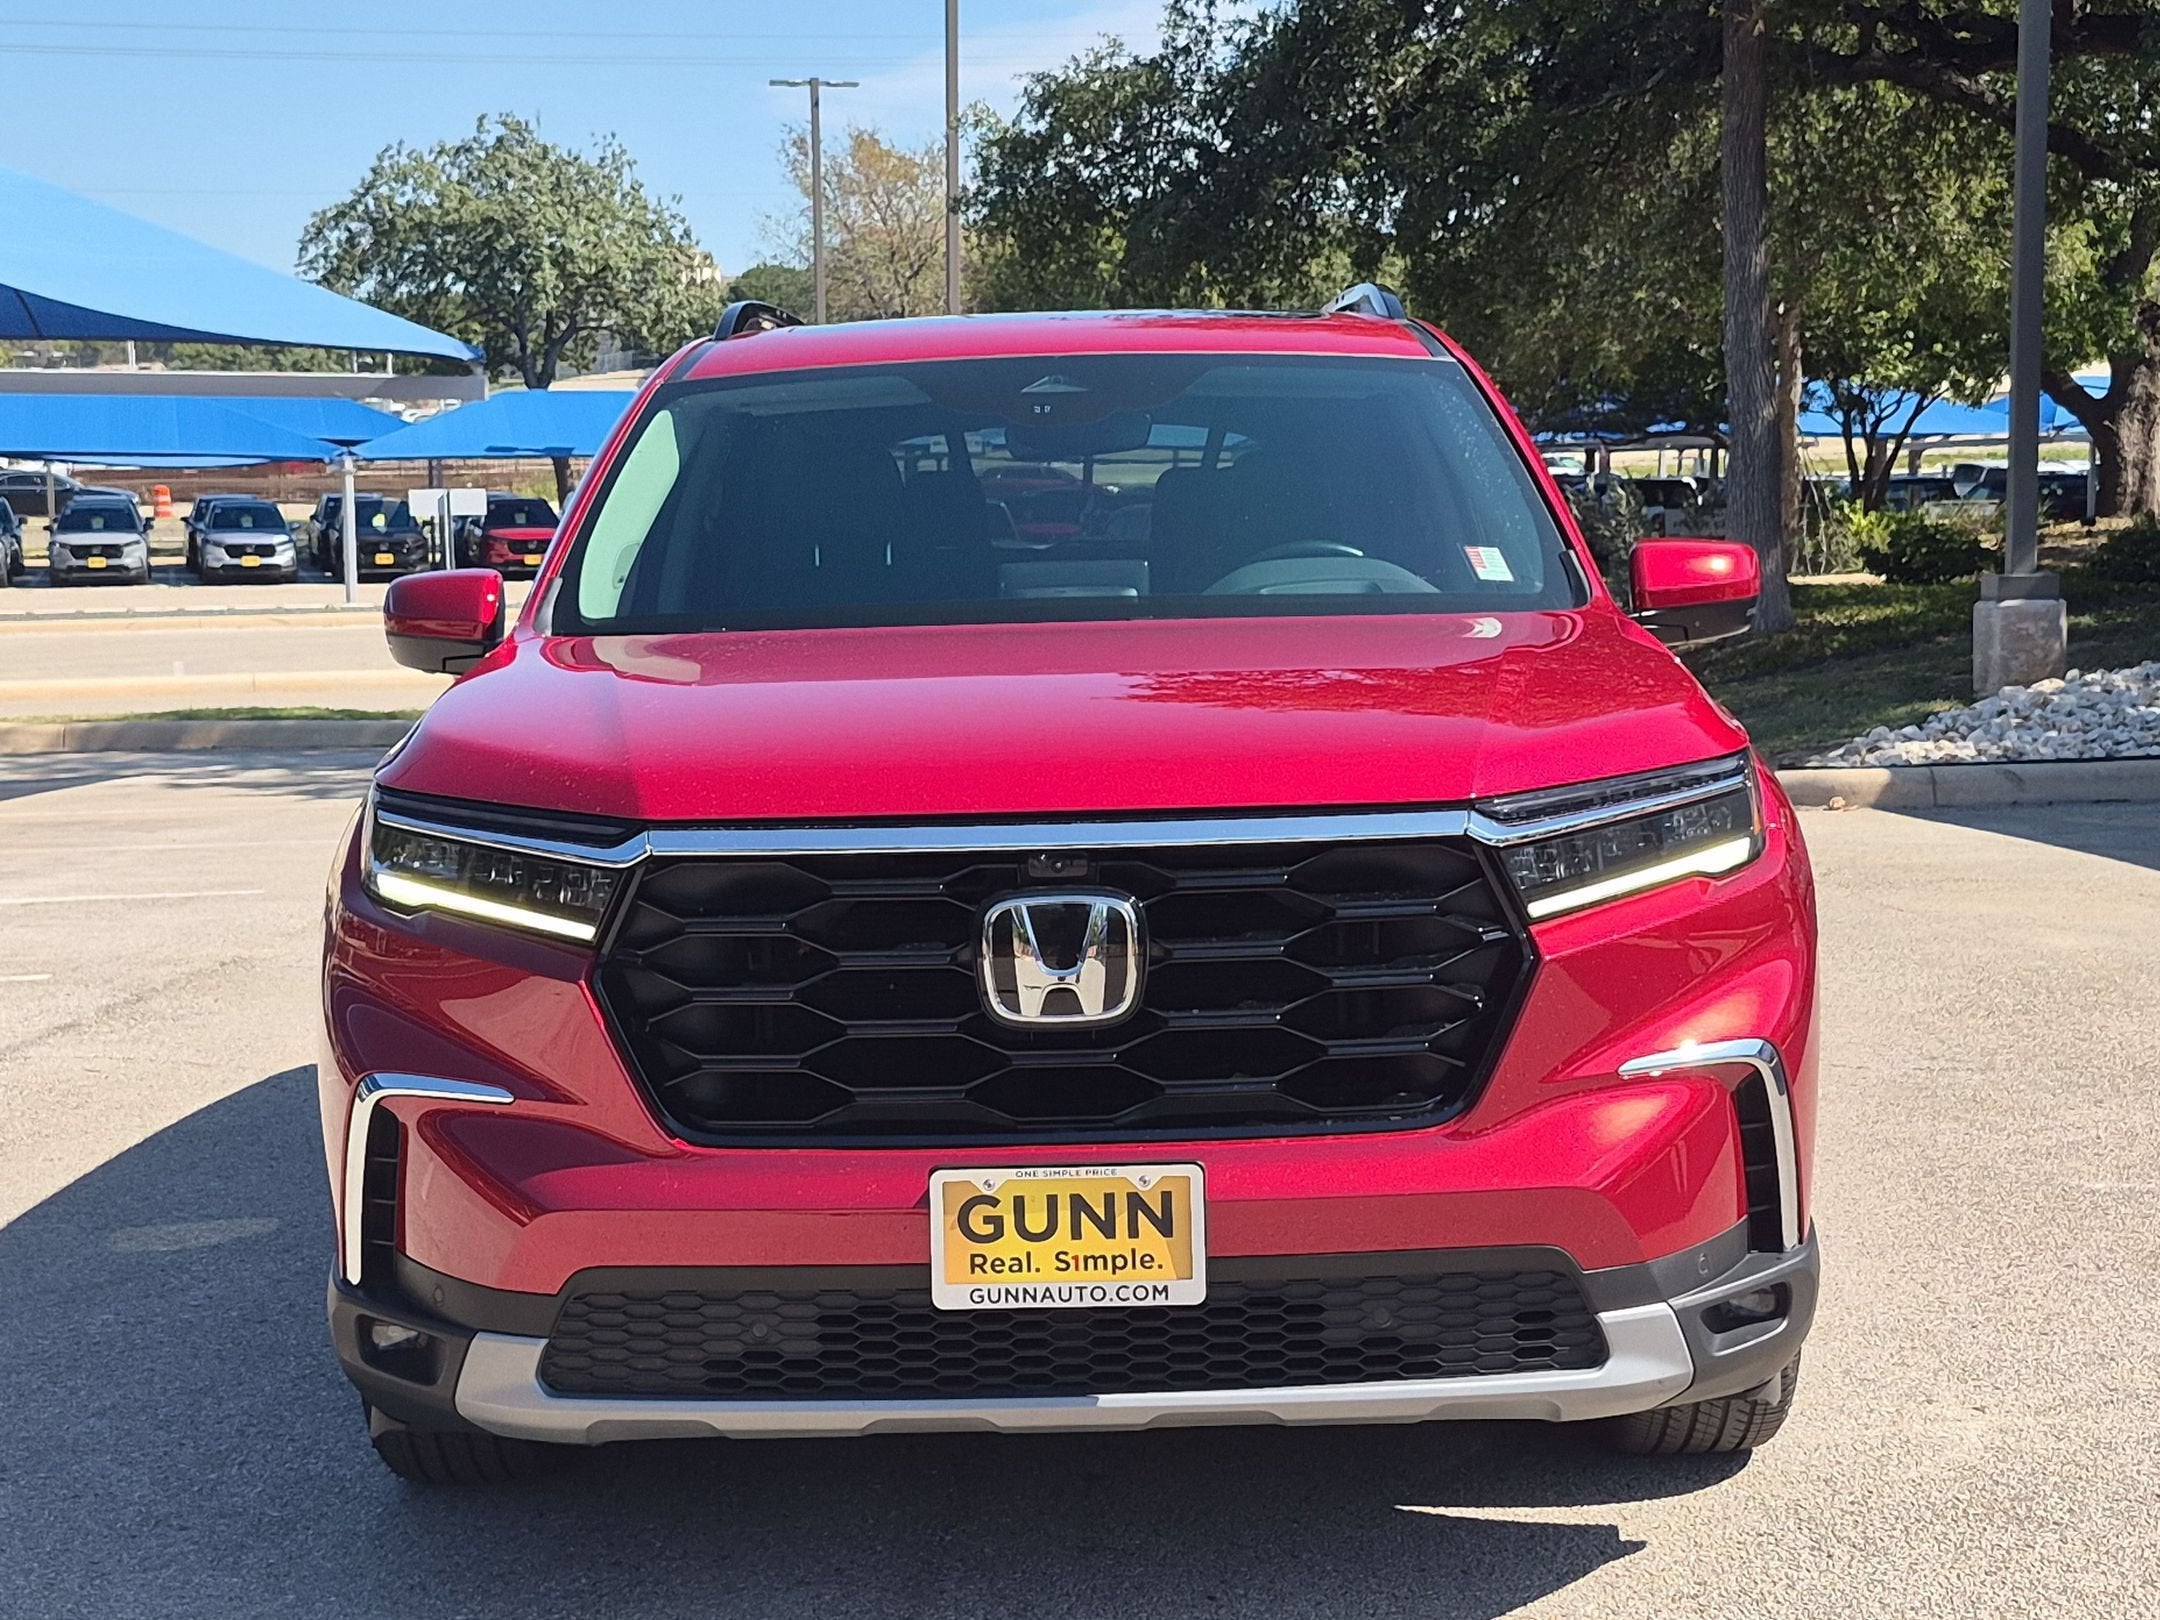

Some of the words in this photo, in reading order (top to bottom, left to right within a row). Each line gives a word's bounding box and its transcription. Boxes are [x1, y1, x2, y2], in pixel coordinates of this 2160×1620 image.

[1015, 1170, 1039, 1178] ONE
[1042, 1169, 1082, 1177] SIMPLE
[1085, 1168, 1118, 1176] PRICE
[957, 1190, 1174, 1244] GUNN
[970, 1251, 1041, 1275] Real.
[969, 1284, 1169, 1305] GUNNAUTO.COM
